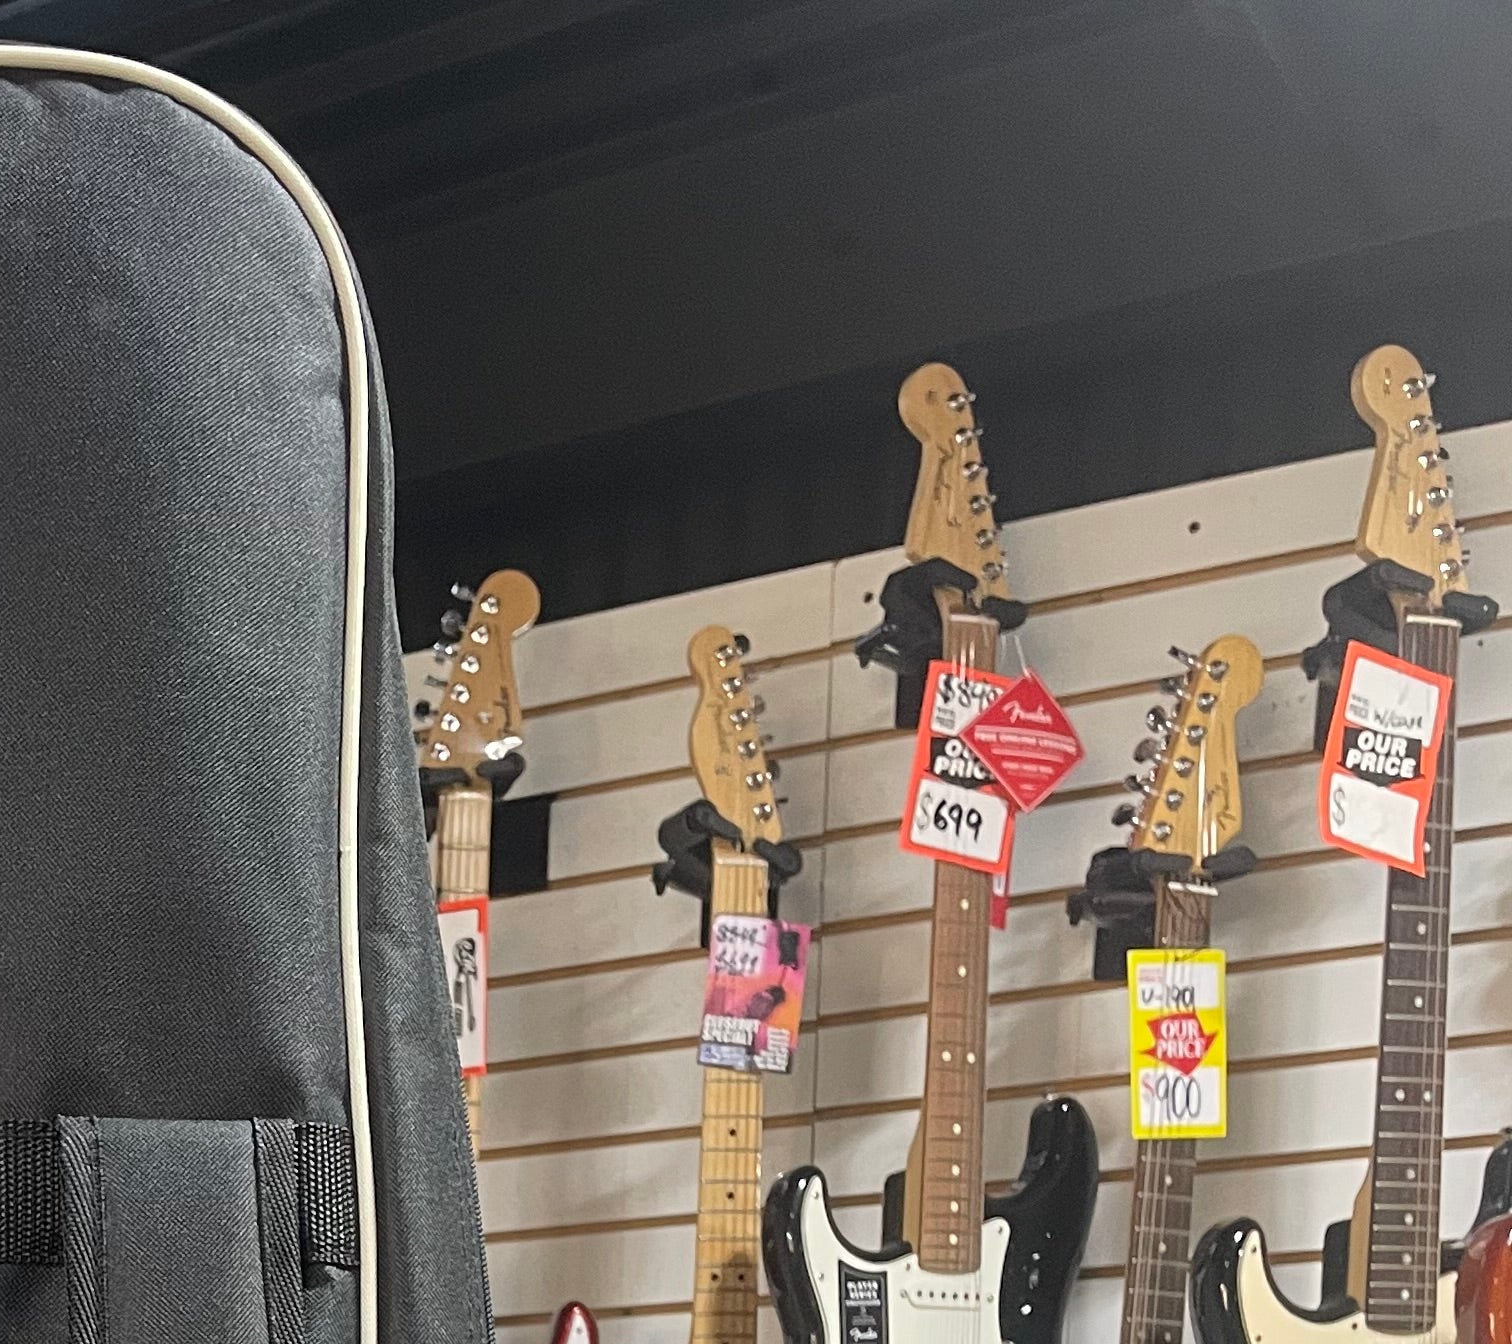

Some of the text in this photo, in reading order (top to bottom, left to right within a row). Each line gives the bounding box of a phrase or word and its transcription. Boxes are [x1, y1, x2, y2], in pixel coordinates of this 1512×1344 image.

[1357, 730, 1408, 759] OUR
[934, 755, 996, 780] PRIC
[1345, 747, 1417, 779] PRICE
[1160, 1018, 1200, 1040] OUR
[1156, 1038, 1207, 1060] PRICE
